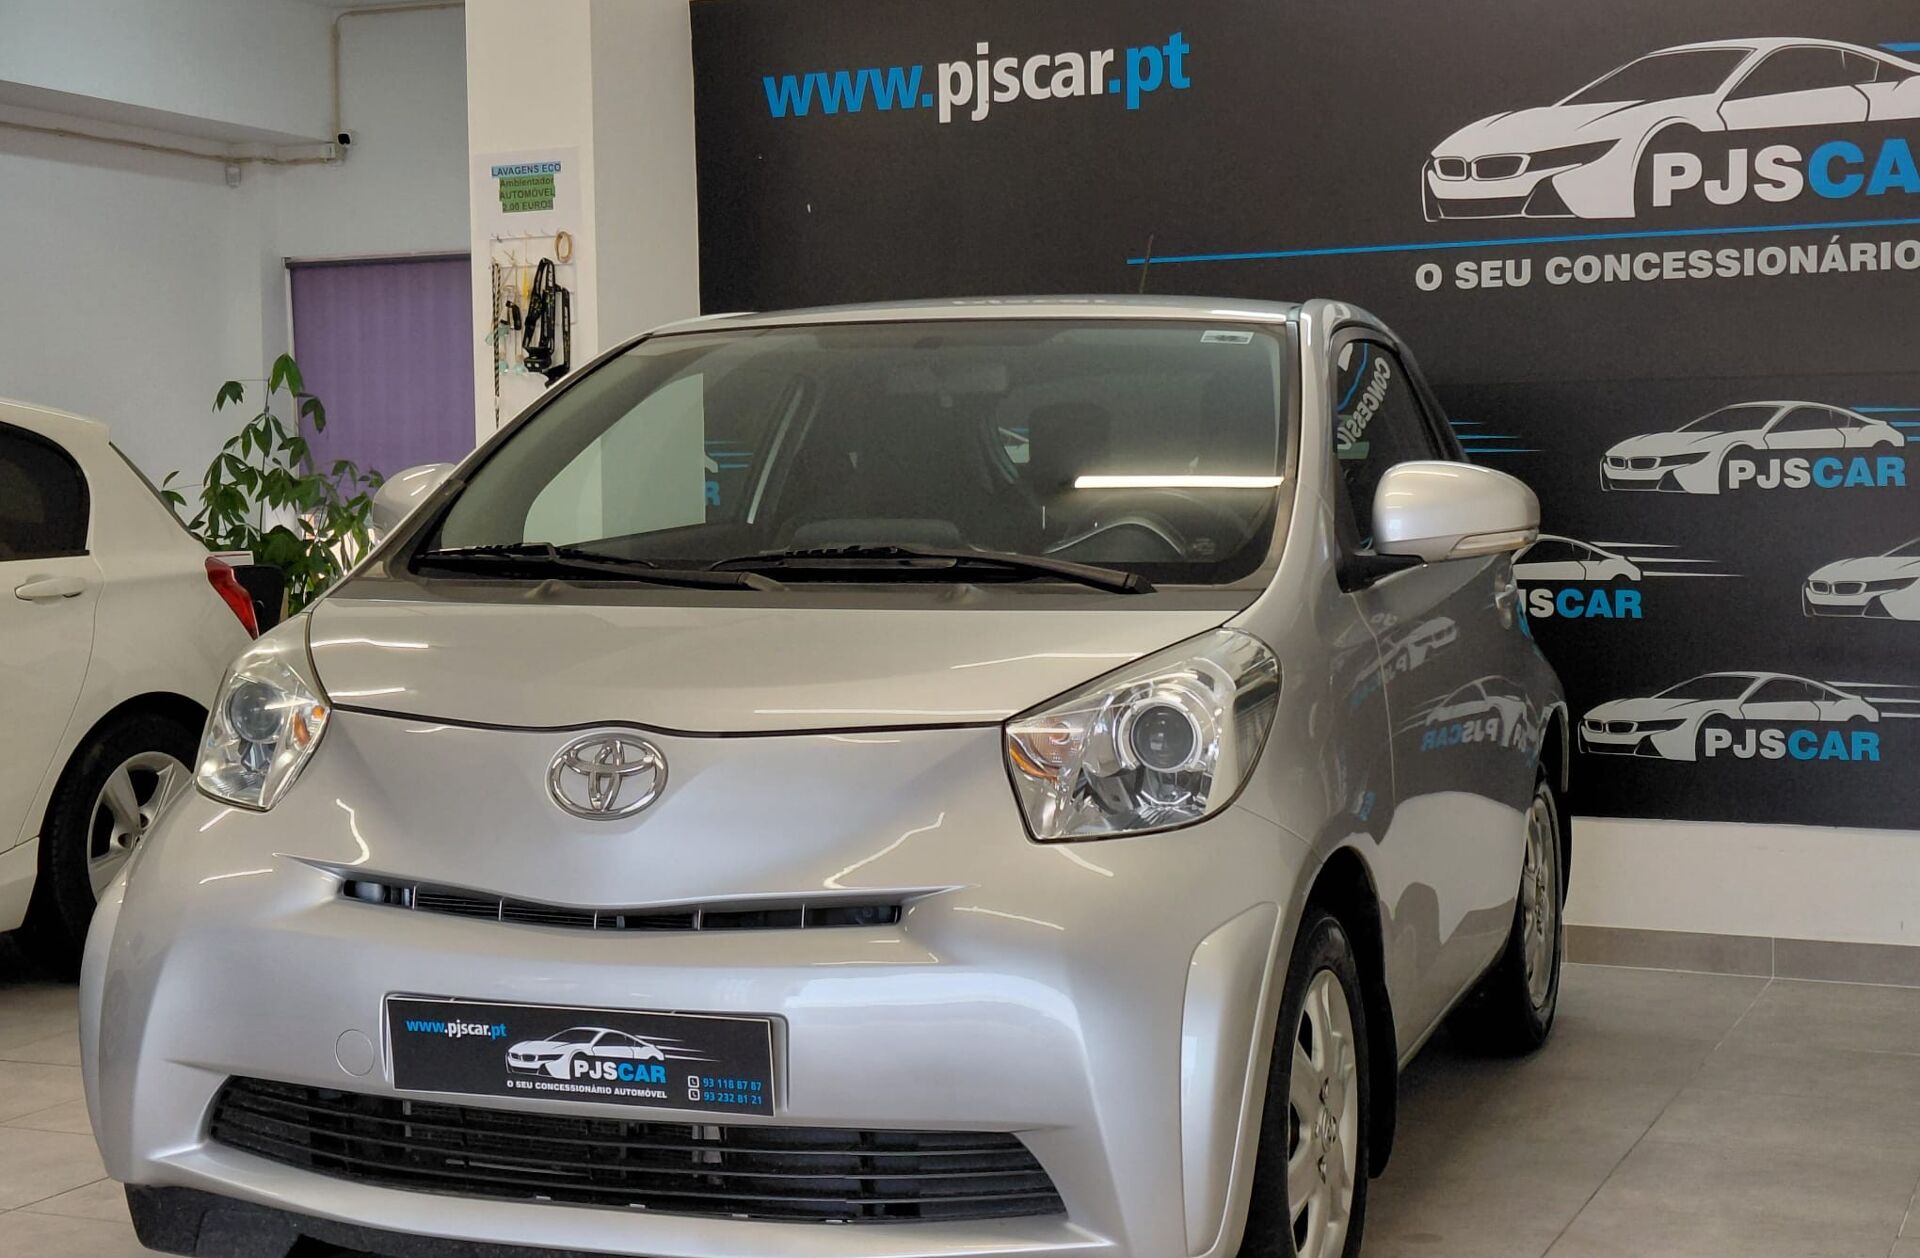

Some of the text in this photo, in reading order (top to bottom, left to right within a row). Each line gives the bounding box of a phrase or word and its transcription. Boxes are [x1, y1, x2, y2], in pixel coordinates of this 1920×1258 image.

[762, 31, 1190, 124] www.pjscar.pt
[491, 163, 561, 177] LAVAGENS ECO
[1415, 235, 1920, 291] O SEU CONCESSIONÁRIO
[1728, 455, 1906, 490] PJSCAR
[1704, 727, 1880, 761] PJSCAR
[405, 1018, 507, 1038] www.pjscar.pt
[573, 1059, 667, 1084] PJSCAR
[506, 1080, 514, 1088] O
[515, 1081, 533, 1089] SEU
[703, 1077, 714, 1088] 93
[717, 1079, 735, 1089] 118
[703, 1091, 716, 1102] 93
[717, 1092, 735, 1103] 232
[751, 1095, 762, 1105] 21
